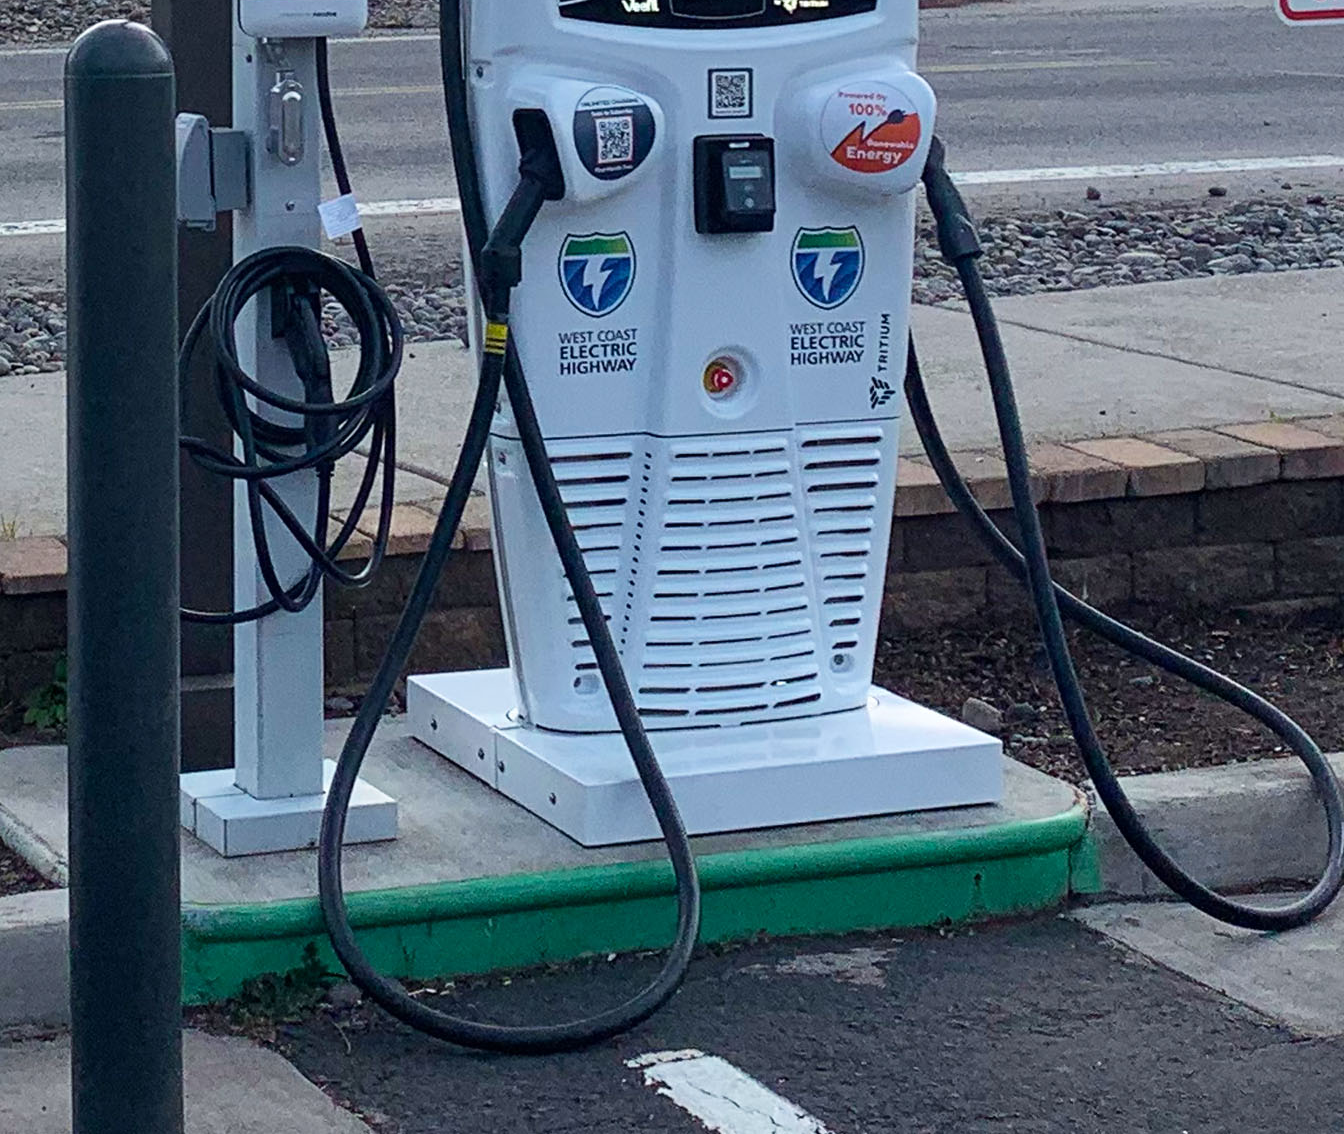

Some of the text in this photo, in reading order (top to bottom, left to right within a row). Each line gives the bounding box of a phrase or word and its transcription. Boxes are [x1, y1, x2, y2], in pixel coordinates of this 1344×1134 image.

[849, 103, 888, 117] 100%
[846, 146, 902, 164] Energy
[558, 328, 638, 344] WEST COAST
[789, 321, 866, 335] WEST COAST
[790, 334, 865, 350] ELECTRIC
[878, 313, 891, 372] TRITIUM
[560, 342, 638, 360] ELECTRIC
[790, 350, 865, 365] HIGHWAY
[560, 358, 637, 376] HIGHWAY
